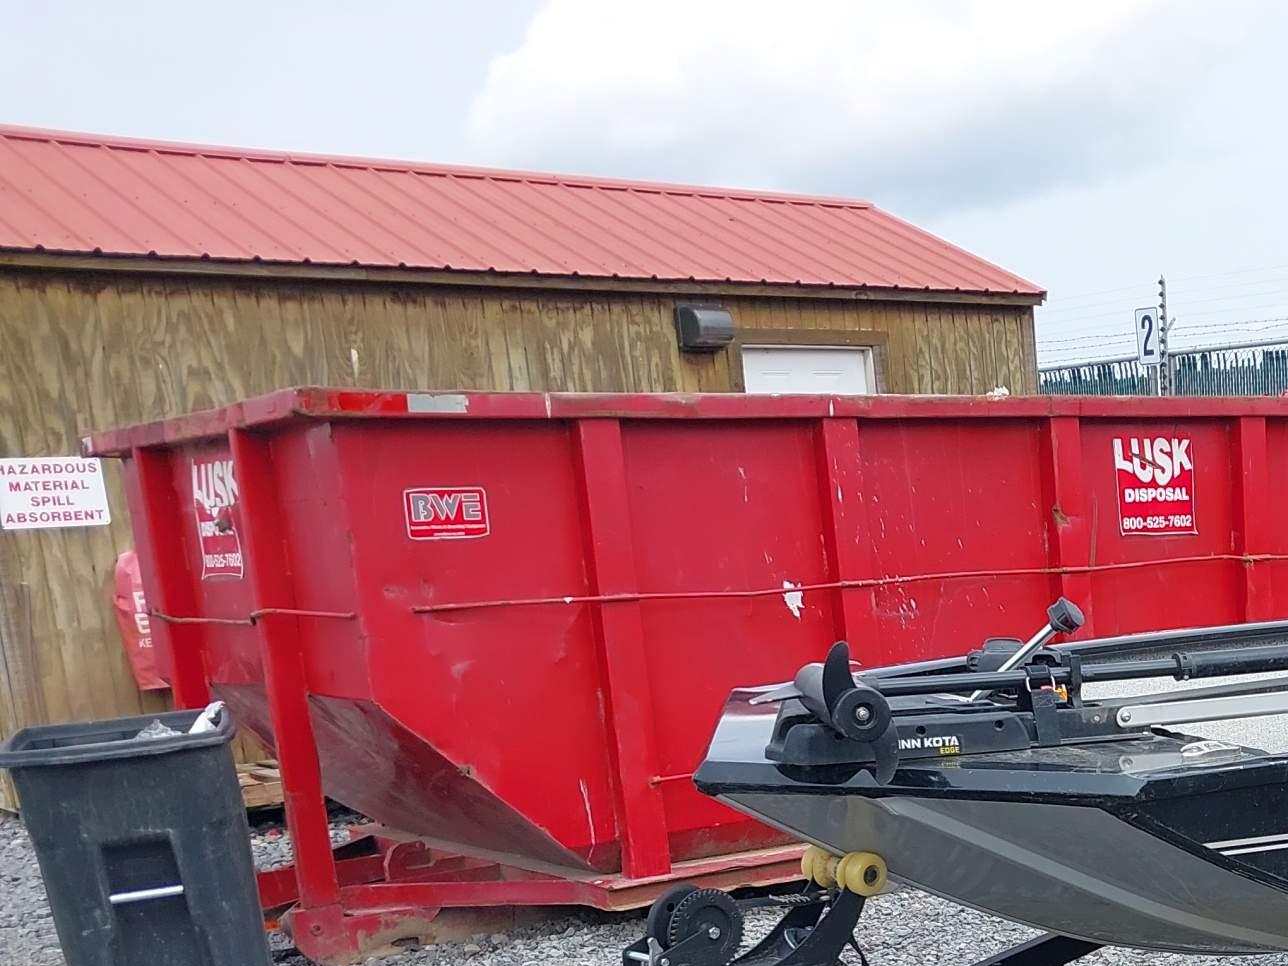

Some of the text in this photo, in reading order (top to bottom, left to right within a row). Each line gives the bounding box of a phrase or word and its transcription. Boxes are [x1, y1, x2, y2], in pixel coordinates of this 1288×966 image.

[1140, 315, 1154, 356] 2
[1113, 437, 1193, 486] LUSK
[8, 480, 90, 492] MATERIAL
[192, 460, 239, 515] LUSK
[30, 495, 75, 507] SPILL
[1124, 487, 1190, 503] DISPOSAL
[409, 494, 482, 522] BWE
[6, 510, 104, 524] ABSORBENT
[1122, 515, 1193, 530] 800-525-7602
[898, 736, 960, 750] INN KOTA
